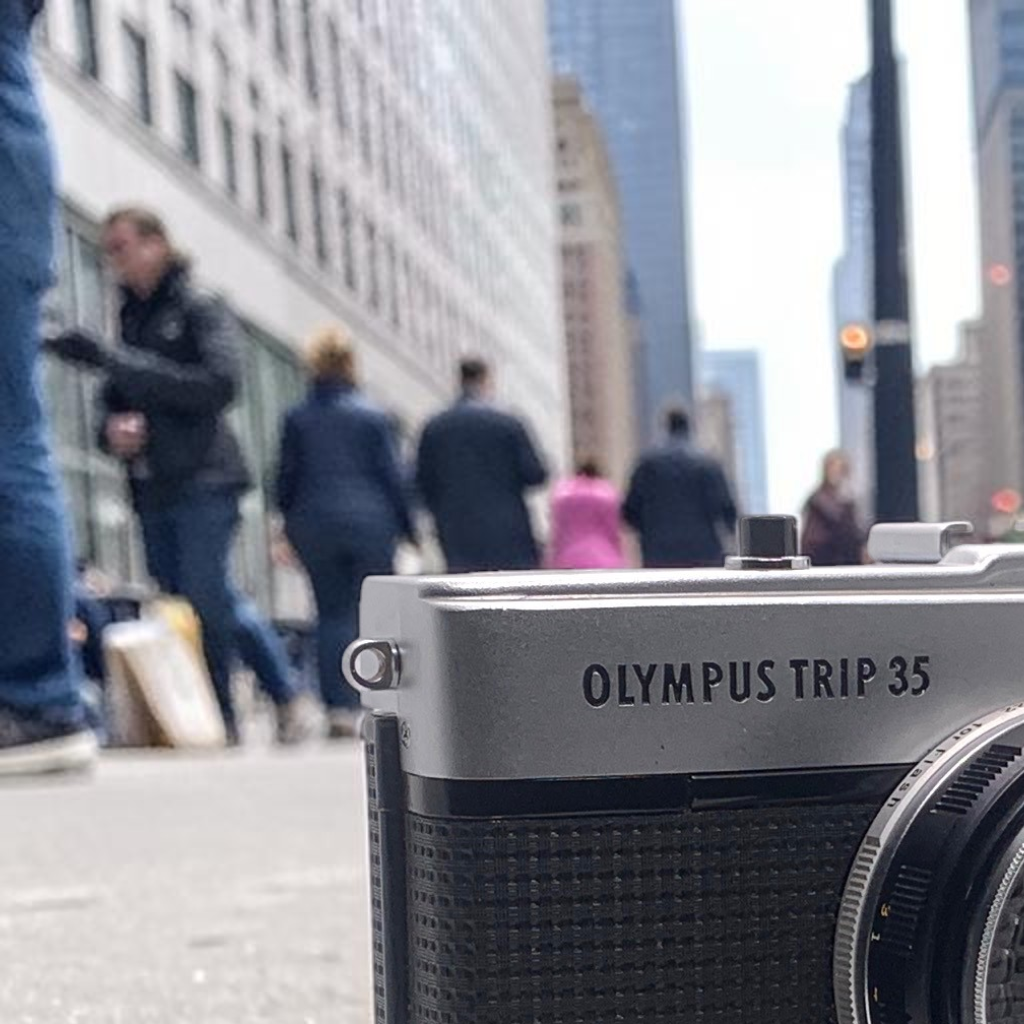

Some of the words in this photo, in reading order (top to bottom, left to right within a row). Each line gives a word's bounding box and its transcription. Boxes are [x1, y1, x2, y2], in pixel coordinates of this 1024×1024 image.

[582, 659, 776, 708] OLYMPUS
[789, 657, 877, 700] TRIP
[887, 655, 930, 698] 35
[887, 749, 946, 807] Flash
